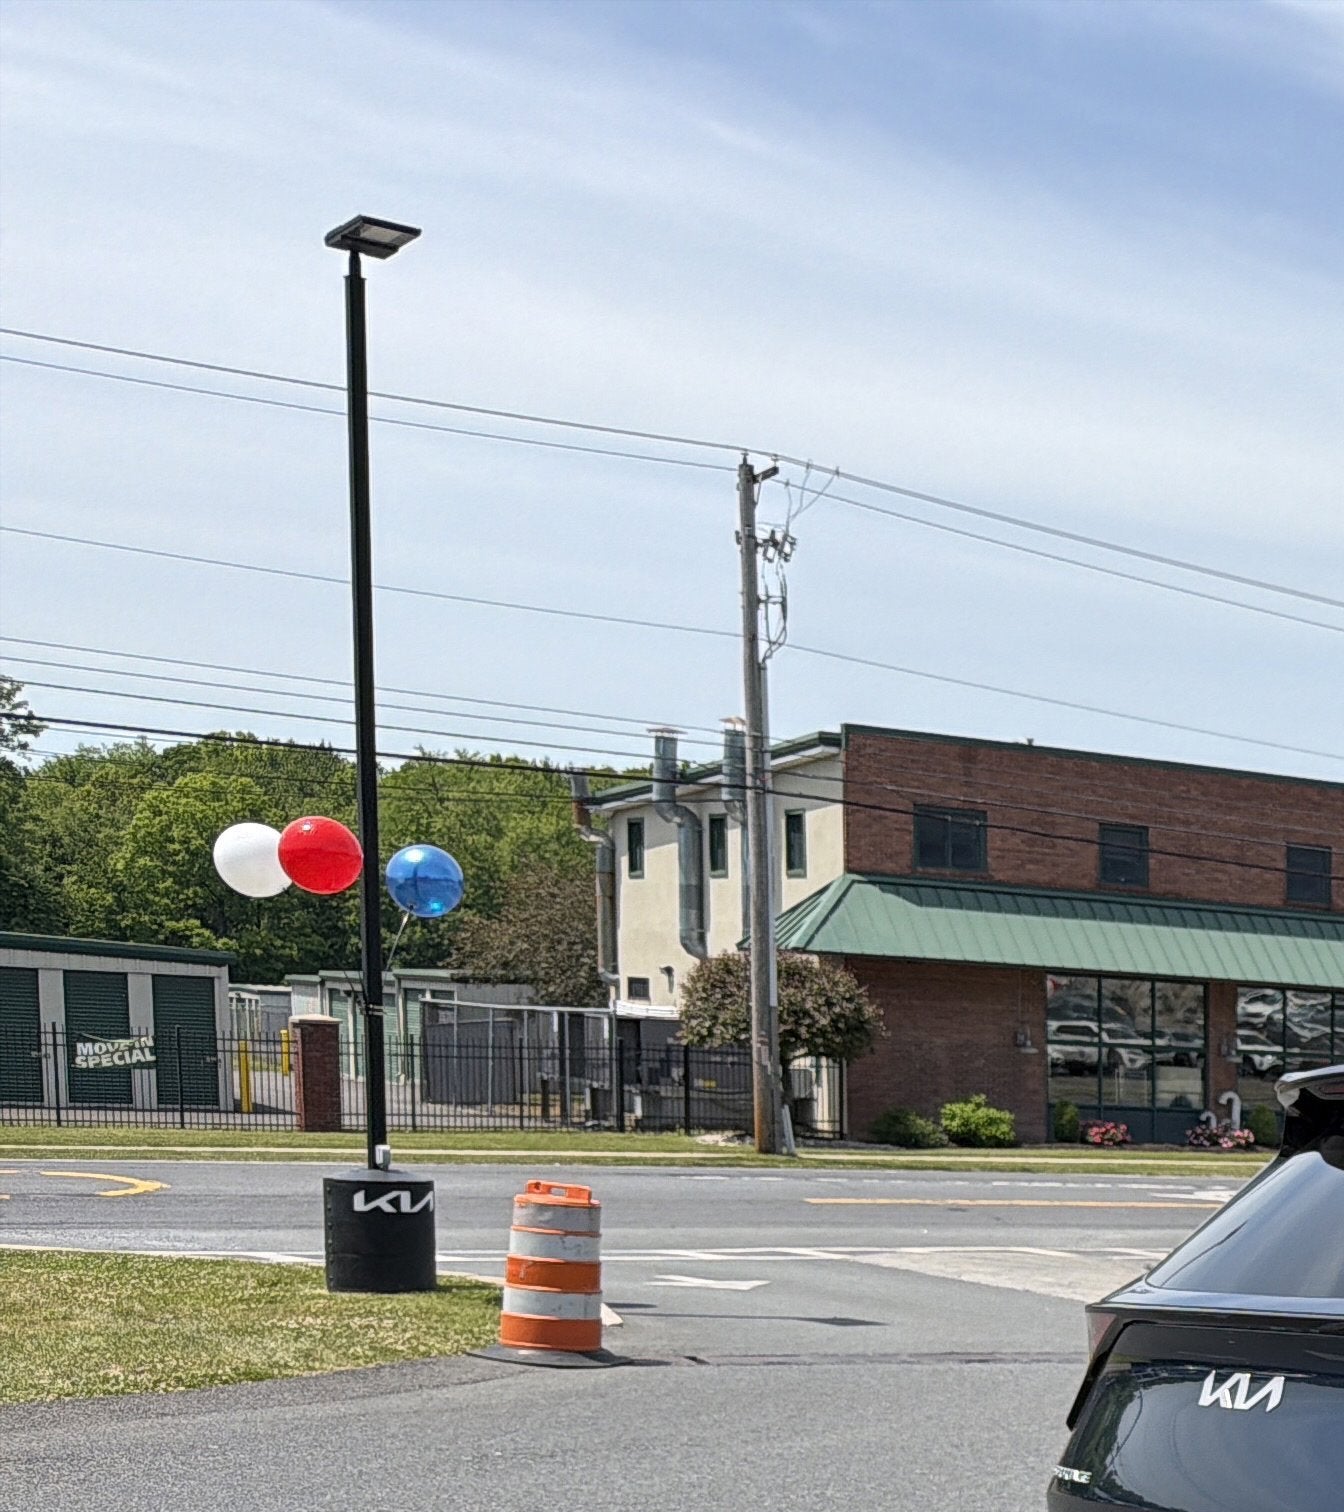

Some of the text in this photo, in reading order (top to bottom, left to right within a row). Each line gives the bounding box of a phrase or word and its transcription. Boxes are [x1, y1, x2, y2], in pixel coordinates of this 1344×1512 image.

[74, 1047, 157, 1068] SPECIAL
[353, 1189, 434, 1213] KIA
[1198, 1369, 1285, 1412] KIA
